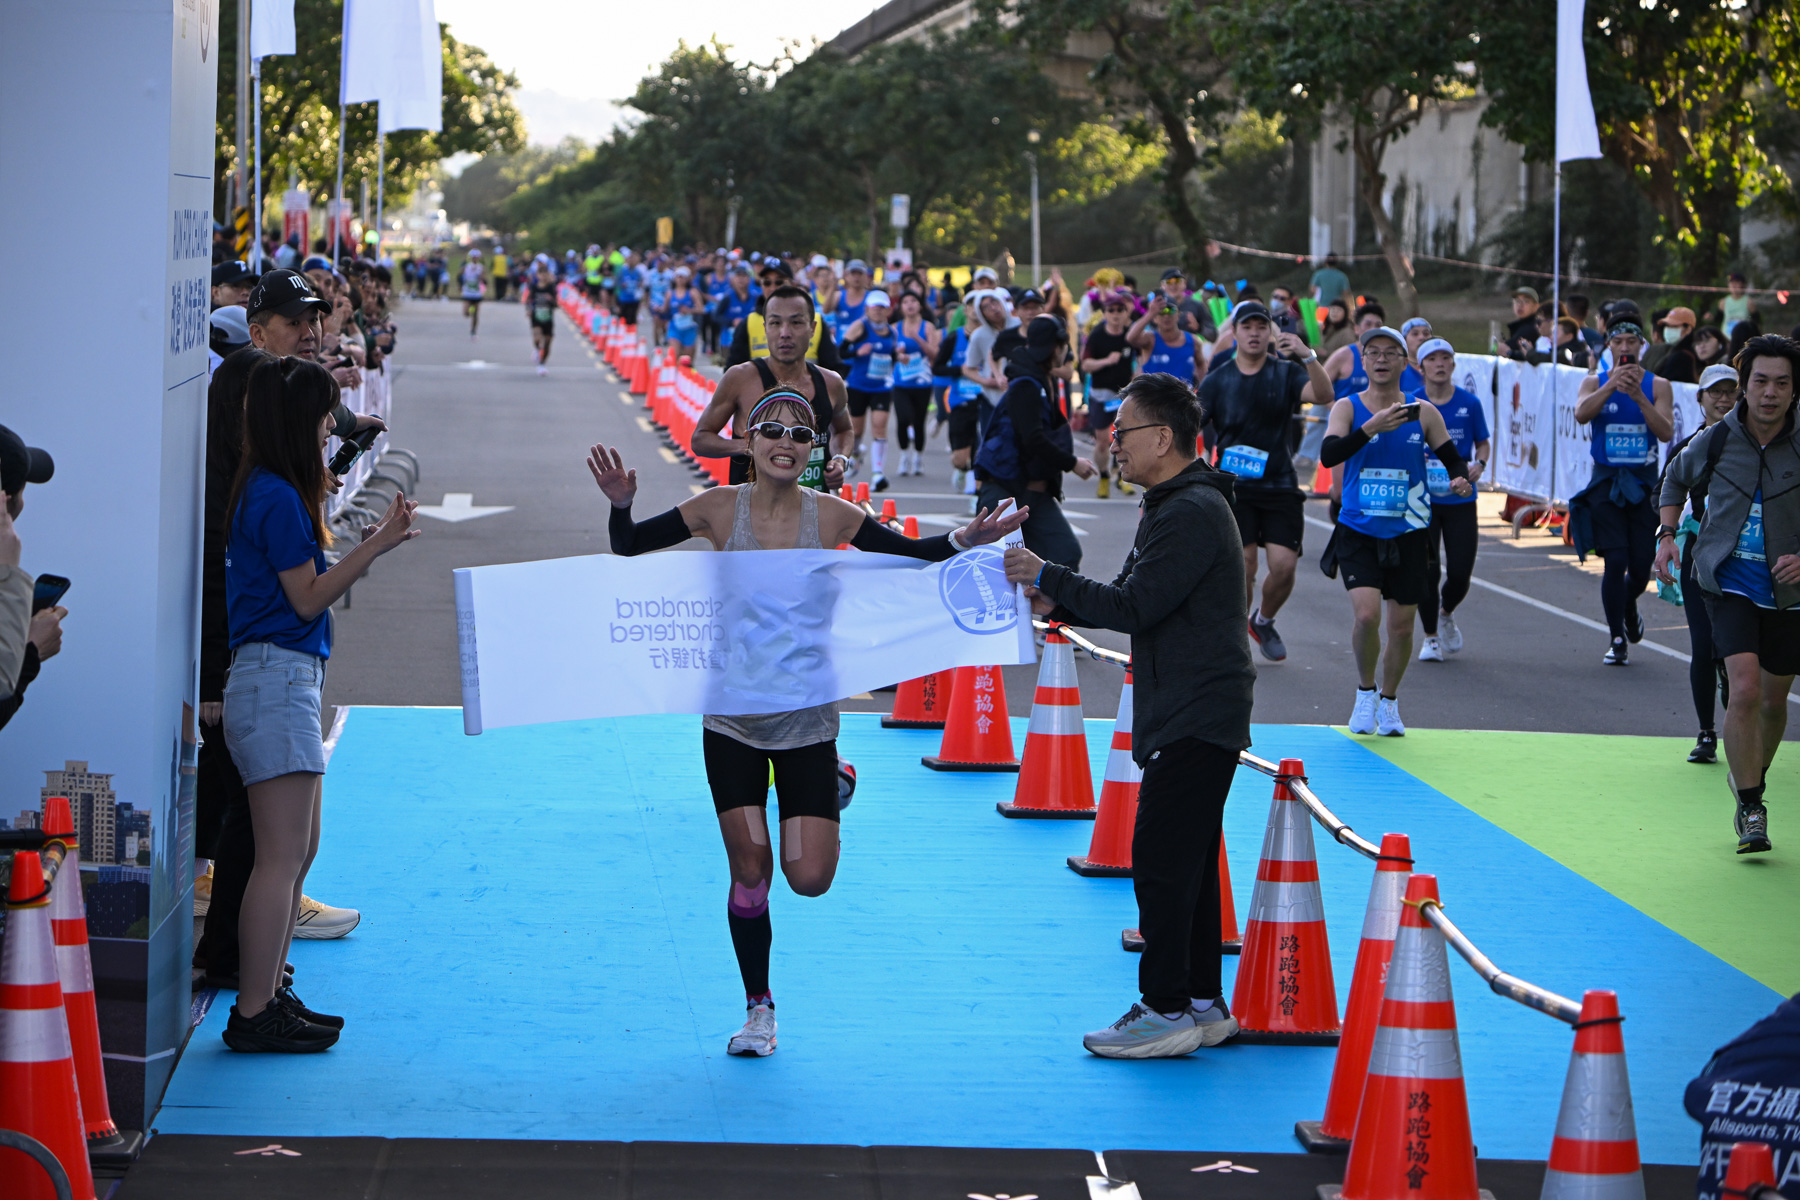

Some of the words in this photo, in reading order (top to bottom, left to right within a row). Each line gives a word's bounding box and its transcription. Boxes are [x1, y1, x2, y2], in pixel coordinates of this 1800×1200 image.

[1608, 436, 1645, 448] 12212
[1225, 455, 1261, 473] 13148
[1361, 483, 1405, 498] 07615
[1278, 935, 1301, 1016] 路跑協會
[1705, 1079, 1800, 1121] 官方攝
[1405, 1091, 1432, 1190] 路跑協會
